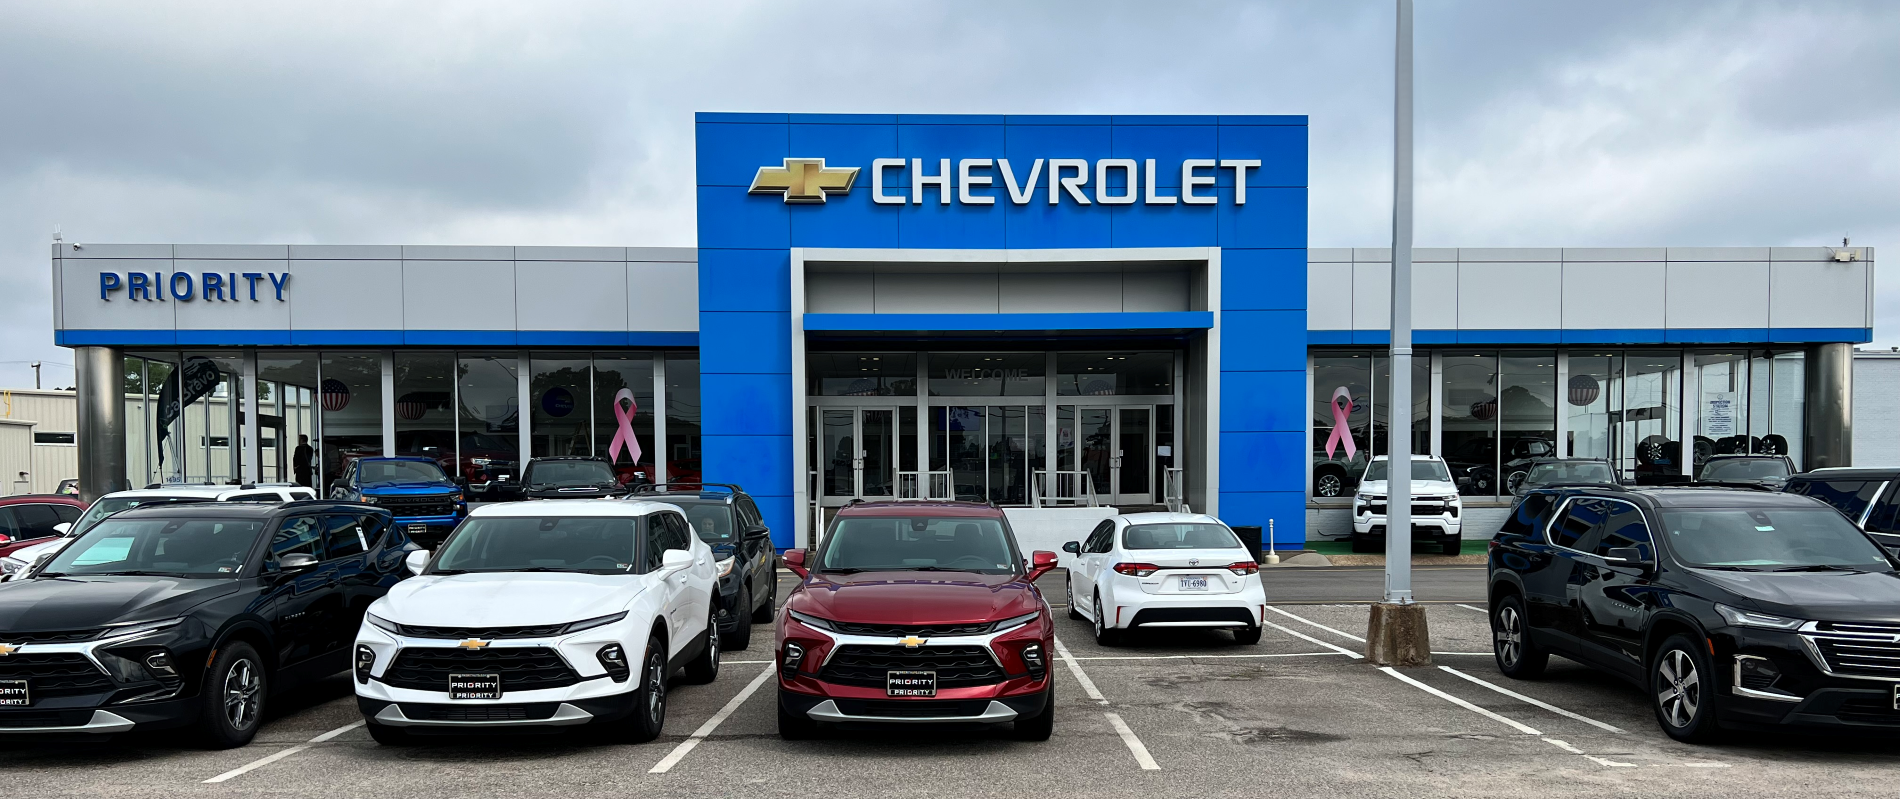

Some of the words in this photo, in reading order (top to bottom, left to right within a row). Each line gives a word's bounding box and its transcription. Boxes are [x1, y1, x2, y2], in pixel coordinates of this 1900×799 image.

[872, 158, 1262, 205] CHEVROLET
[99, 271, 290, 302] PRIORITY
[944, 368, 1029, 382] WELCOME
[889, 678, 934, 686] PRIORITY
